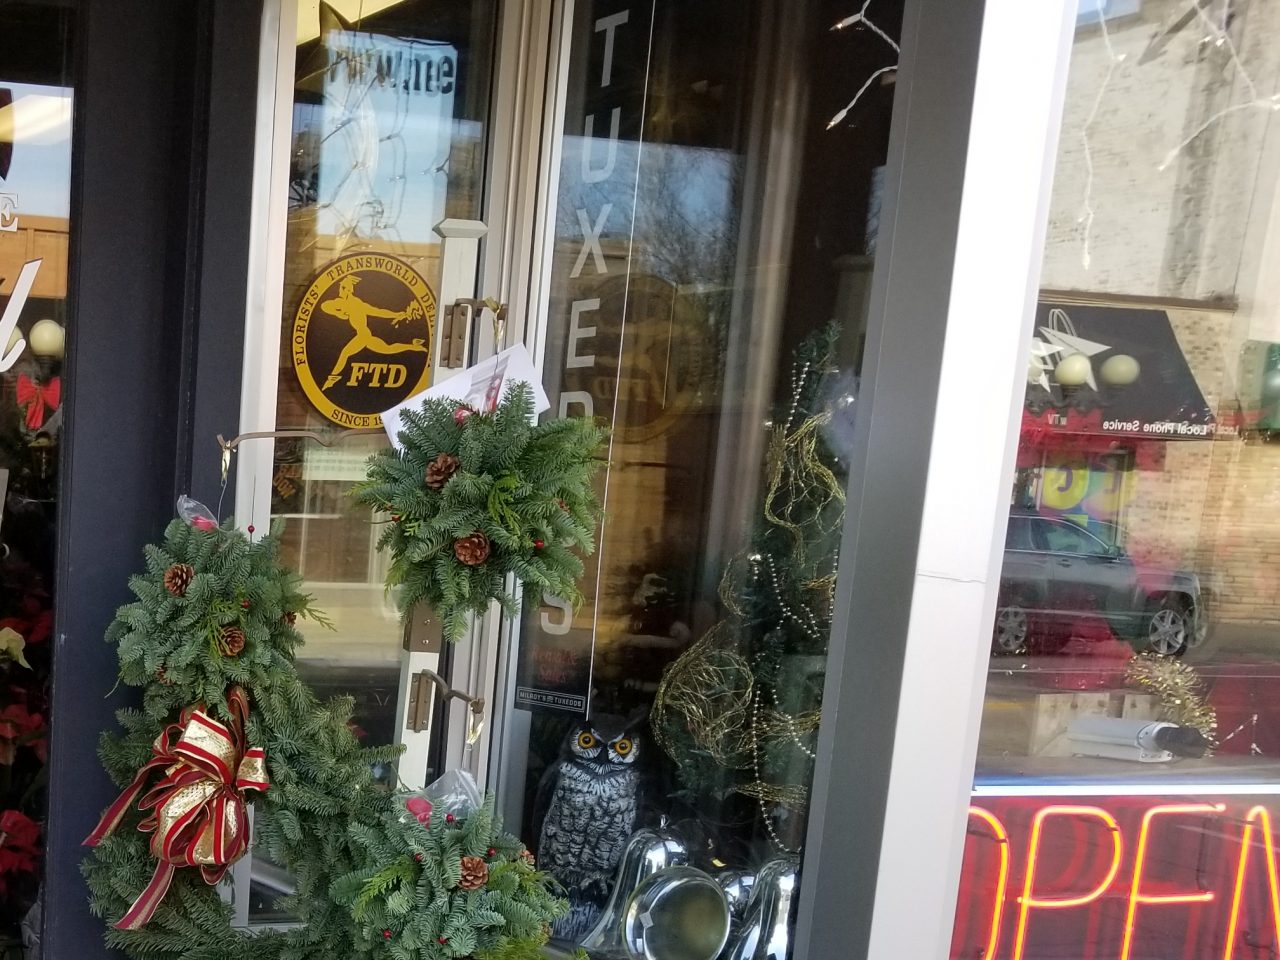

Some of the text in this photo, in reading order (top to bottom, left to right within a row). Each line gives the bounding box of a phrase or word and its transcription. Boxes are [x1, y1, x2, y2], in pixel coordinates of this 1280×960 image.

[326, 256, 419, 288] TRANSWORLD
[346, 362, 407, 388] FTD
[331, 409, 370, 427] SINCE
[555, 696, 582, 707] TUXEDOS
